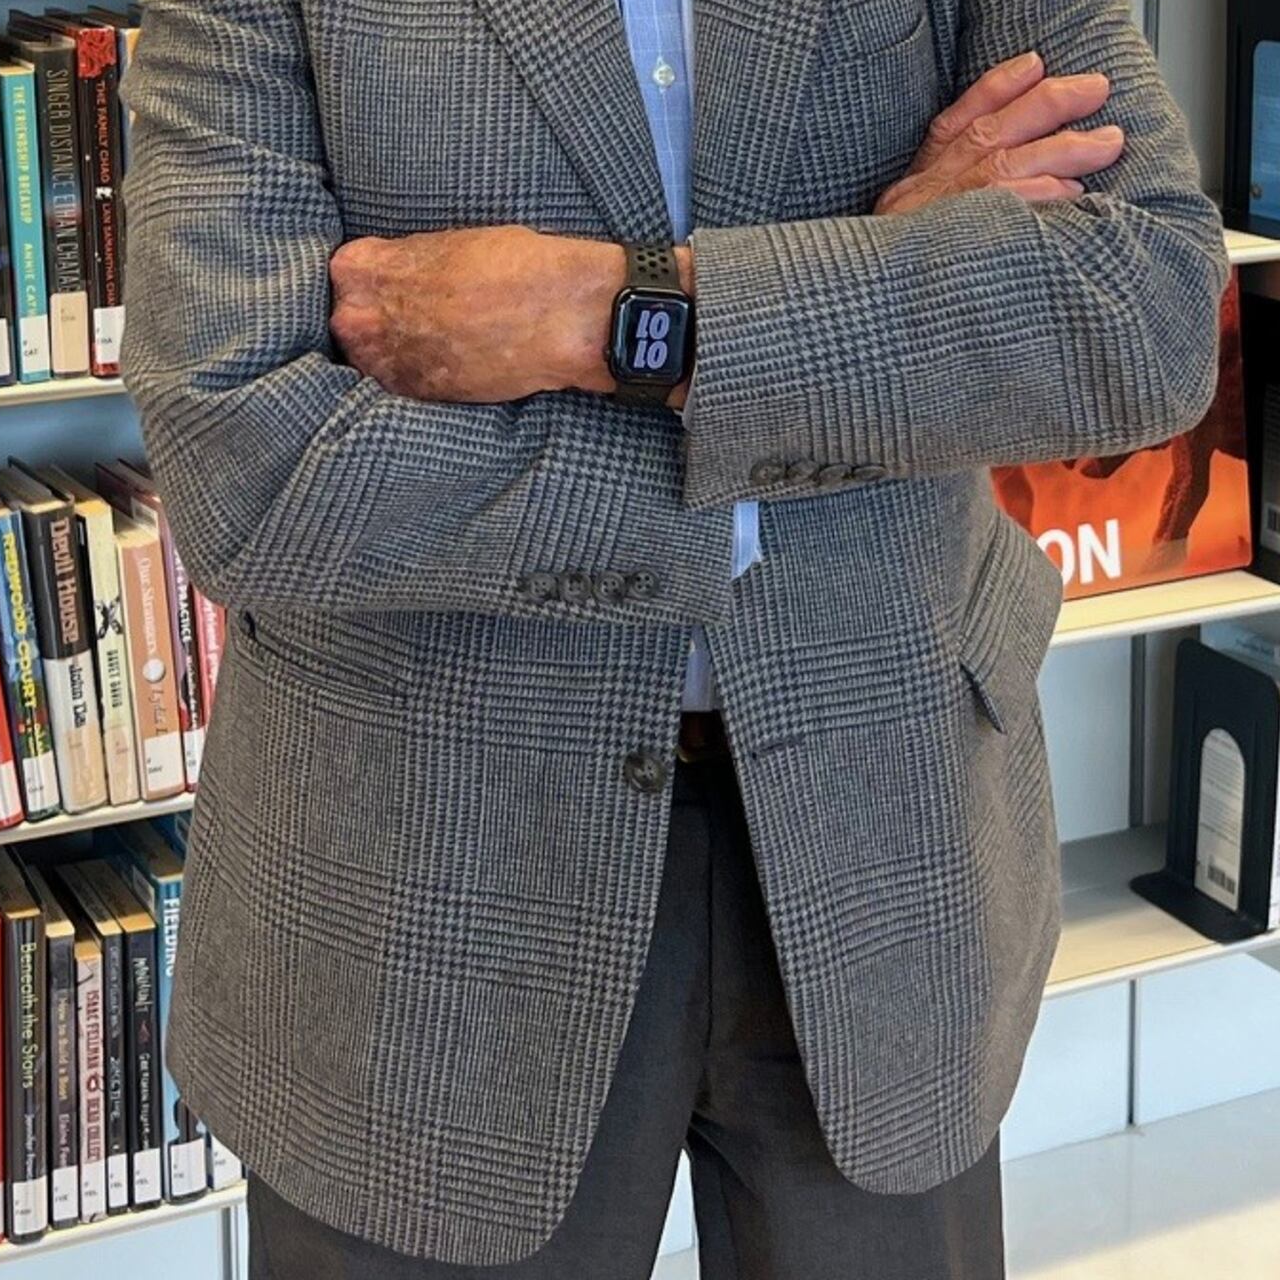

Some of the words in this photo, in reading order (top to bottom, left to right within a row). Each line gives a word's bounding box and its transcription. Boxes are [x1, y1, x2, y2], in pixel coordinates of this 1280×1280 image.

[636, 310, 670, 340] 10
[633, 339, 668, 369] 10
[50, 517, 75, 575] Devil
[1036, 519, 1122, 587] ON
[56, 577, 82, 645] House
[20, 941, 38, 1011] Beneath
[21, 1013, 38, 1040] the
[21, 1043, 41, 1090] Stairs
